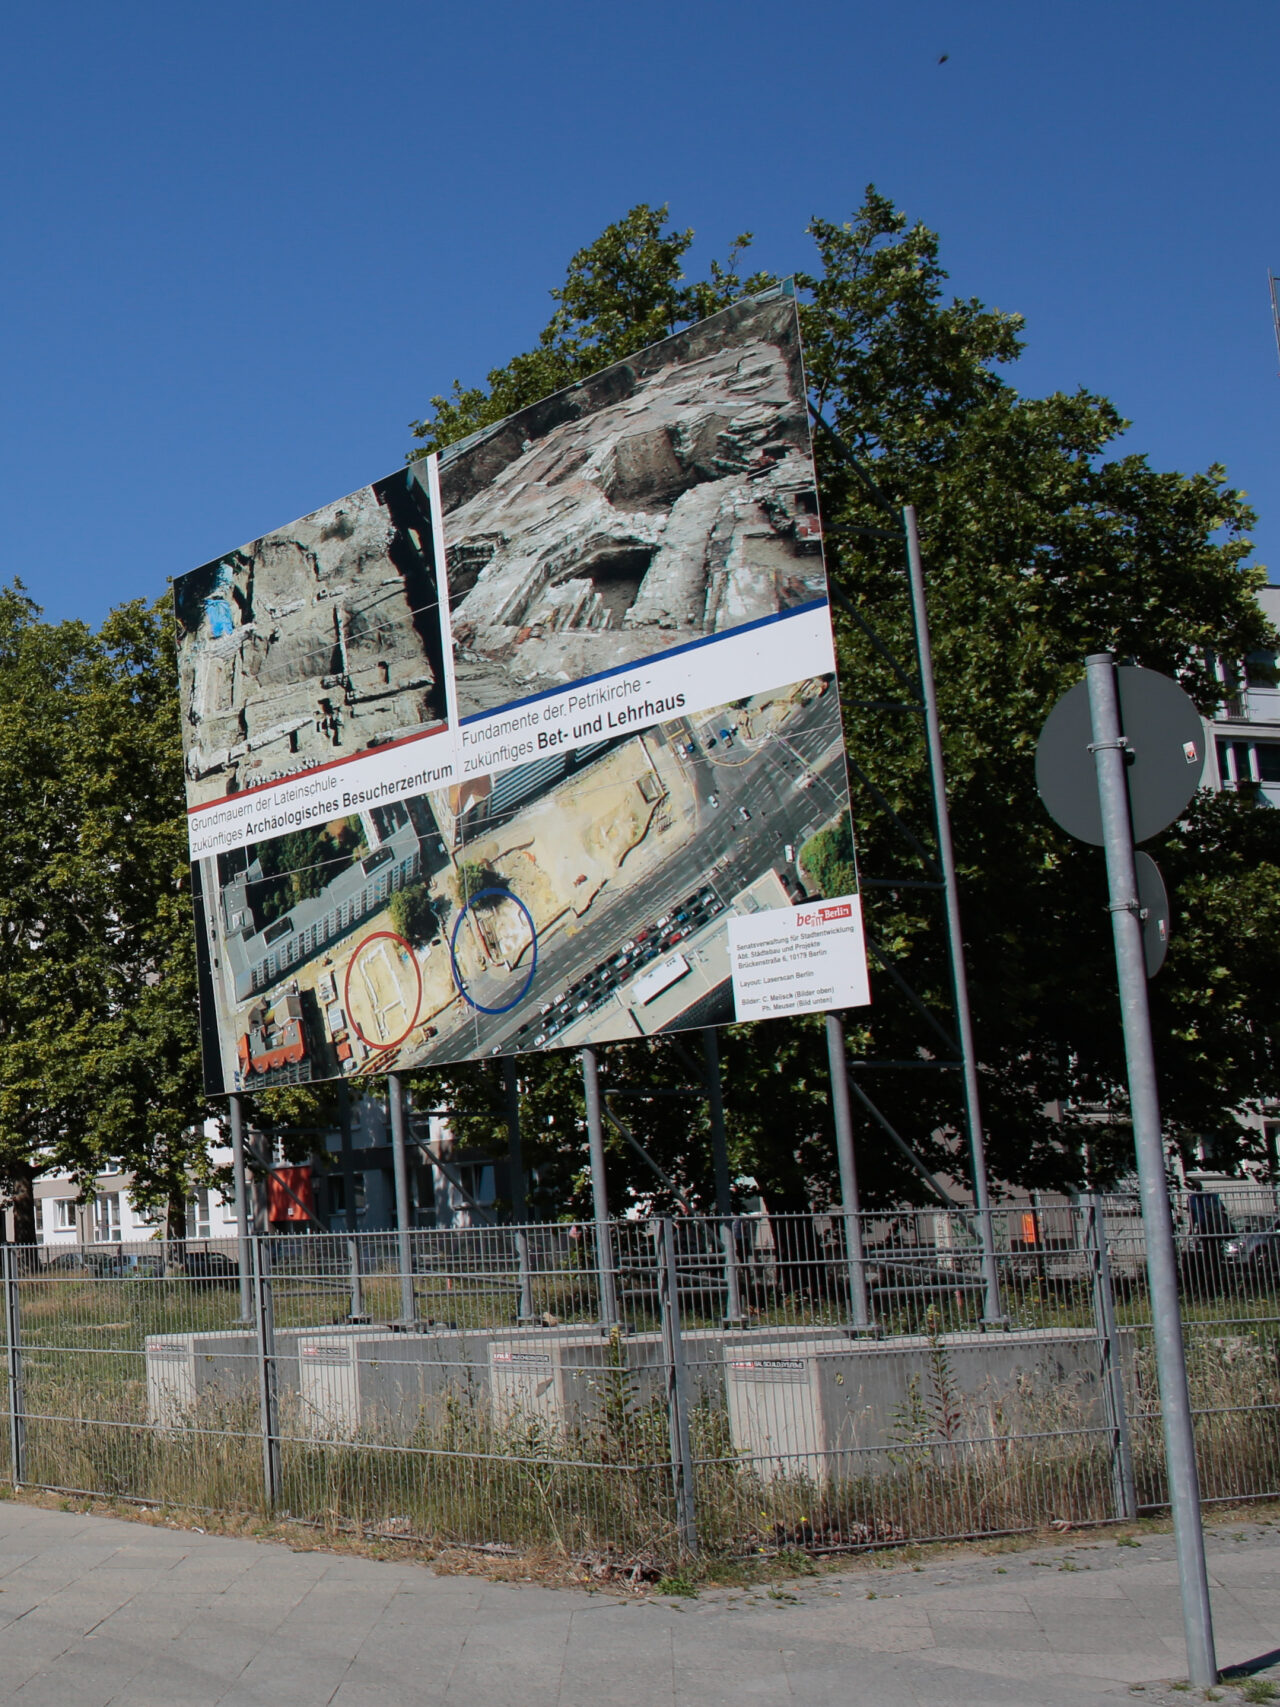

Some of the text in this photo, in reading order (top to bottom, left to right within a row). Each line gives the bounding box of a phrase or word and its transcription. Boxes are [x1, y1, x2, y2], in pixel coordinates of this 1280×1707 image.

[461, 710, 540, 748] Fundamente
[543, 703, 566, 721] der
[568, 678, 642, 715] Petrikirche
[463, 692, 687, 773] zukünftiges Bet- und Lehrhaus
[191, 804, 254, 832] Grundmauern
[256, 796, 272, 812] der
[273, 775, 338, 806] Lateinschule
[191, 763, 454, 854] zukünftiges Archäologisches Besucherzentrum
[823, 906, 850, 919] Berlin
[736, 937, 789, 951] Senatsverwaltung
[800, 926, 855, 940] Stadtentwicklung
[781, 945, 794, 953] und
[794, 941, 821, 951] Projekte
[789, 952, 807, 961] 10179
[808, 949, 827, 958] Berlin
[763, 973, 795, 984] Laserscan
[795, 970, 814, 979] Berlin
